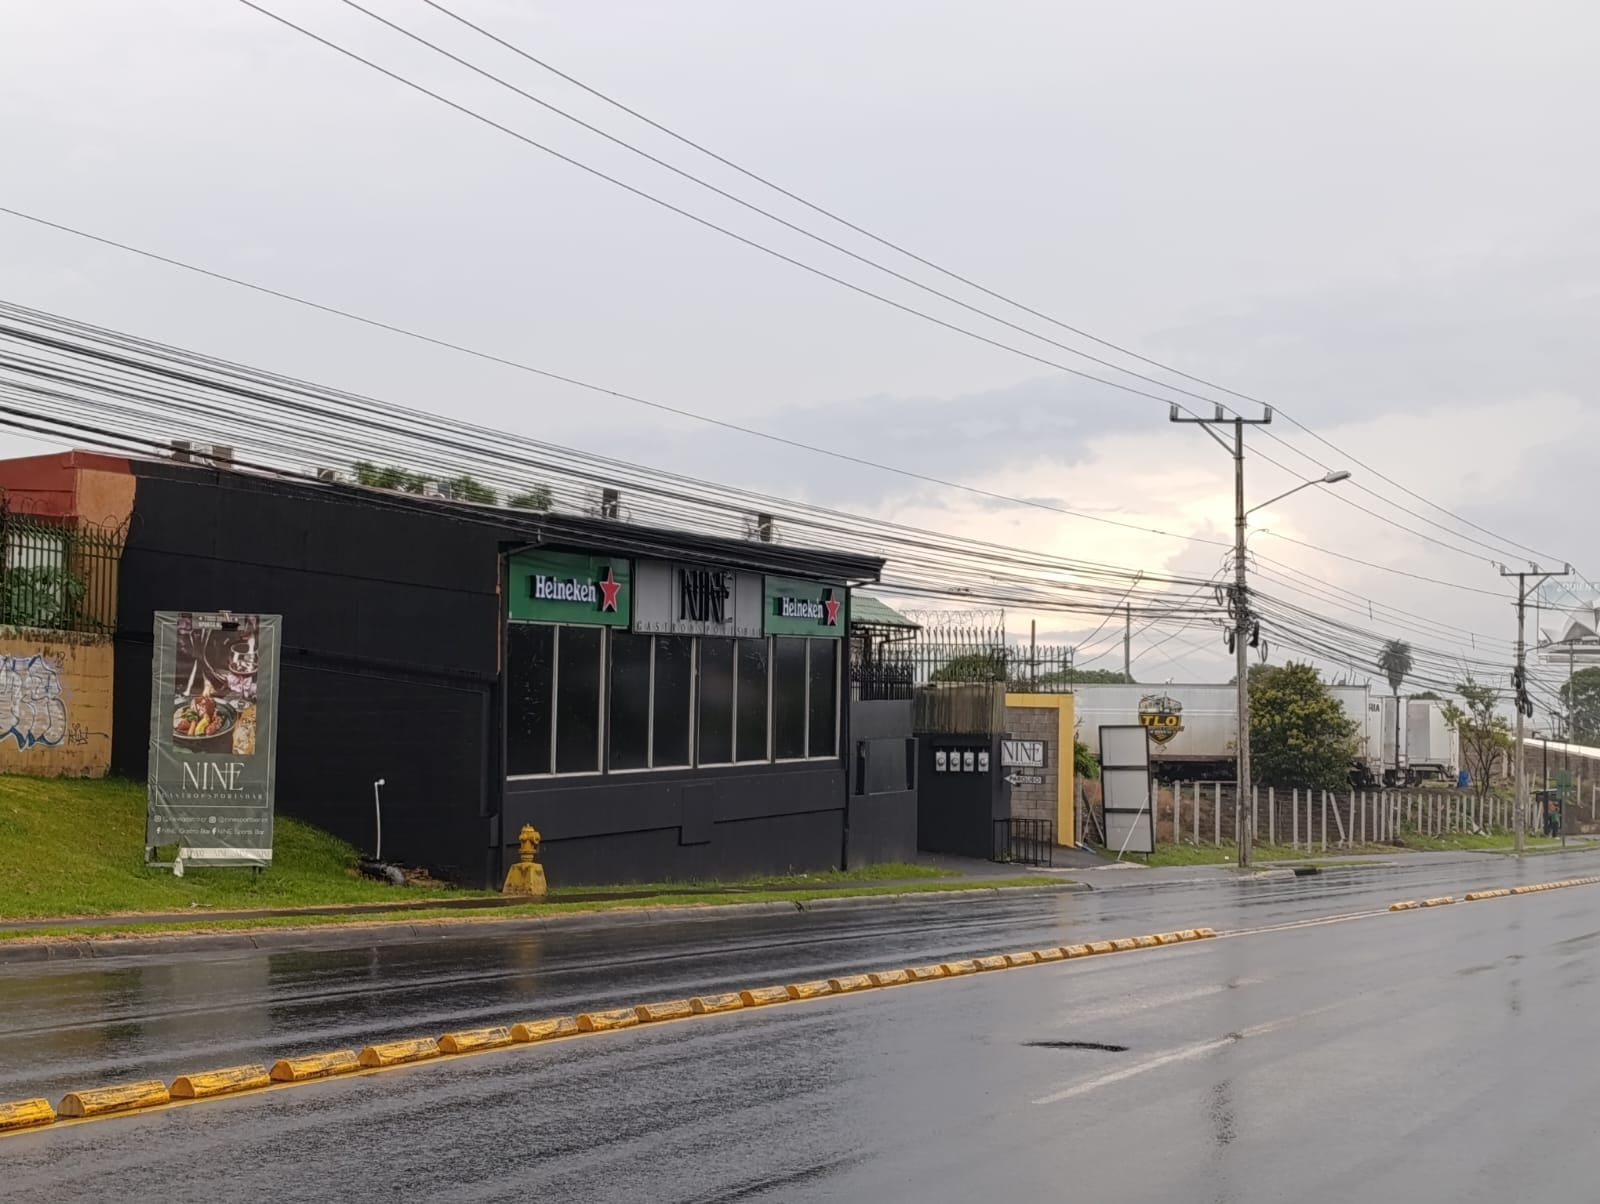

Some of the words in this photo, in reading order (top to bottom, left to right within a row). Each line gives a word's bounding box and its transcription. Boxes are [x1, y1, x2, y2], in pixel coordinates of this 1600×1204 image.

[535, 575, 597, 602] Heineken
[677, 569, 733, 624] NINE
[782, 596, 824, 618] Heineken
[1143, 715, 1178, 727] TLO
[1002, 742, 1042, 762] NINE
[182, 762, 245, 791] NINE
[1009, 775, 1041, 784] PARQUEO
